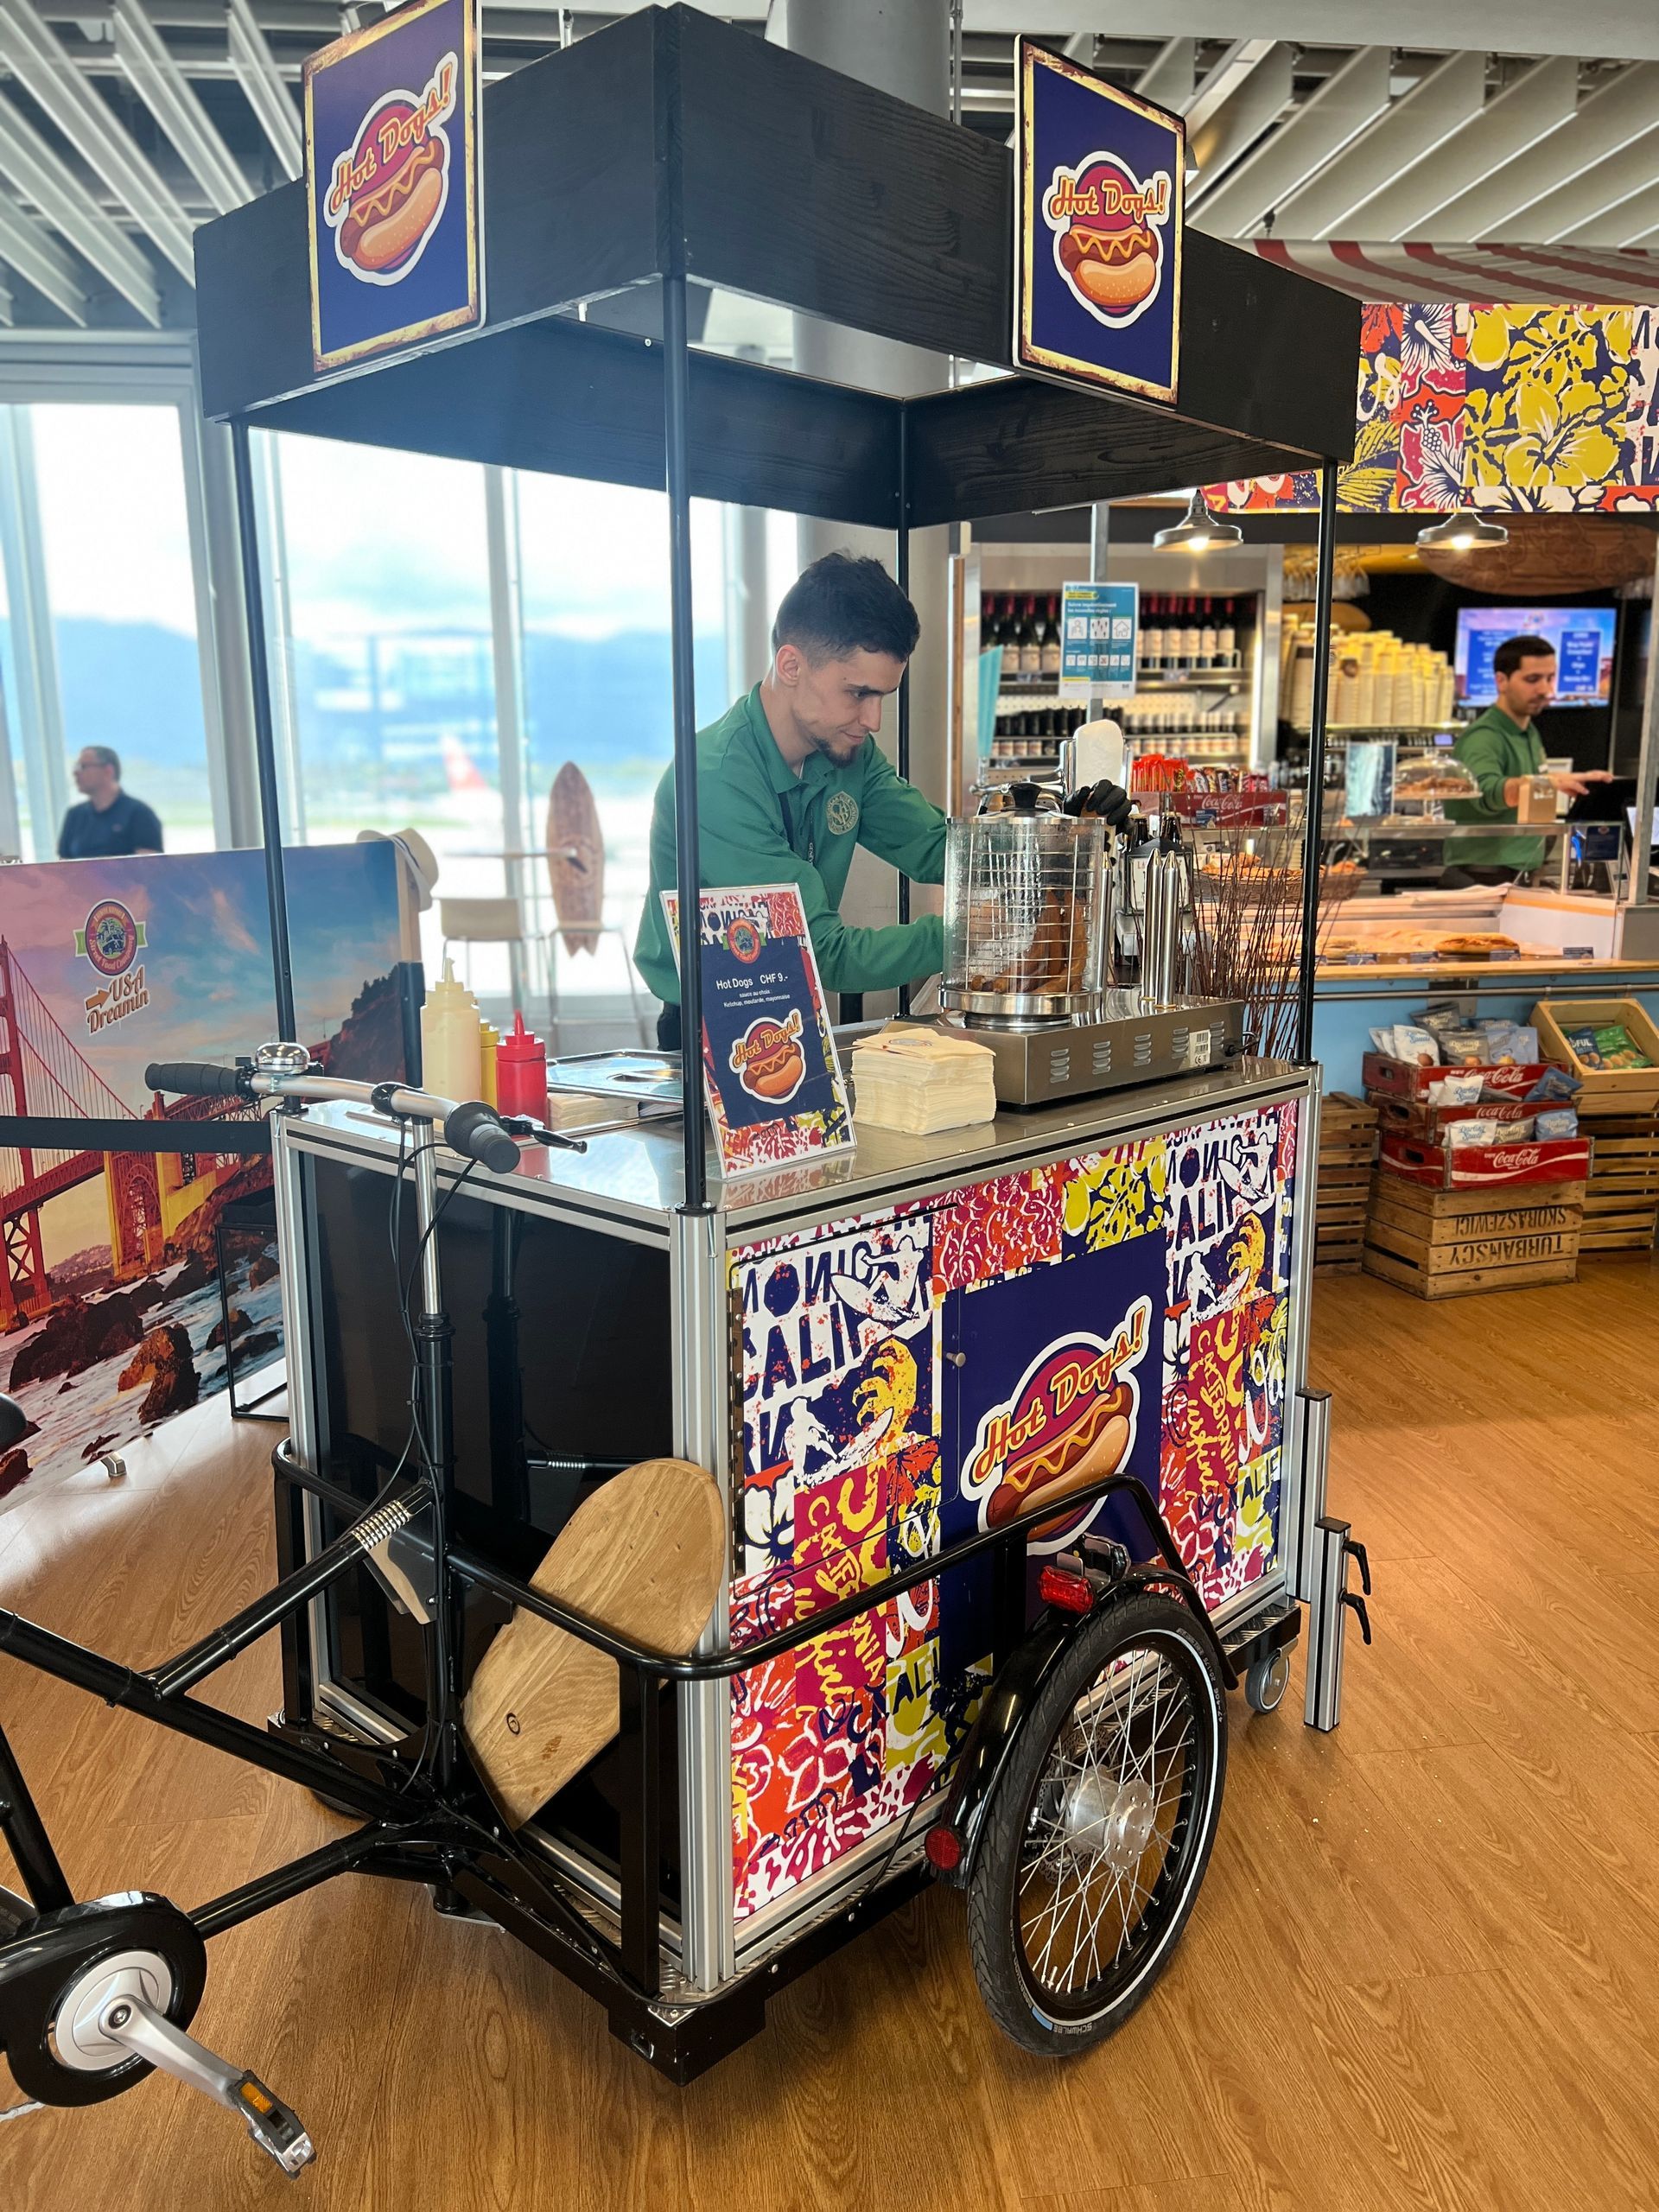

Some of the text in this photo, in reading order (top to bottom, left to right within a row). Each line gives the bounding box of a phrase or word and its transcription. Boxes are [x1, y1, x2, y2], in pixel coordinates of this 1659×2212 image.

[328, 62, 453, 215] Hot Dogs!
[1051, 175, 1167, 225] Hot Dogs!
[111, 965, 145, 1002] USA
[715, 972, 788, 990] Hot Dogs CHF 9.-
[87, 989, 149, 1034] Dreamin
[733, 1012, 800, 1069] Hot Dogs!
[1493, 1147, 1541, 1169] Coca-Cola
[972, 1306, 1147, 1484] Hot Dogs!
[1052, 2022, 1093, 2037] SCHWALBE
